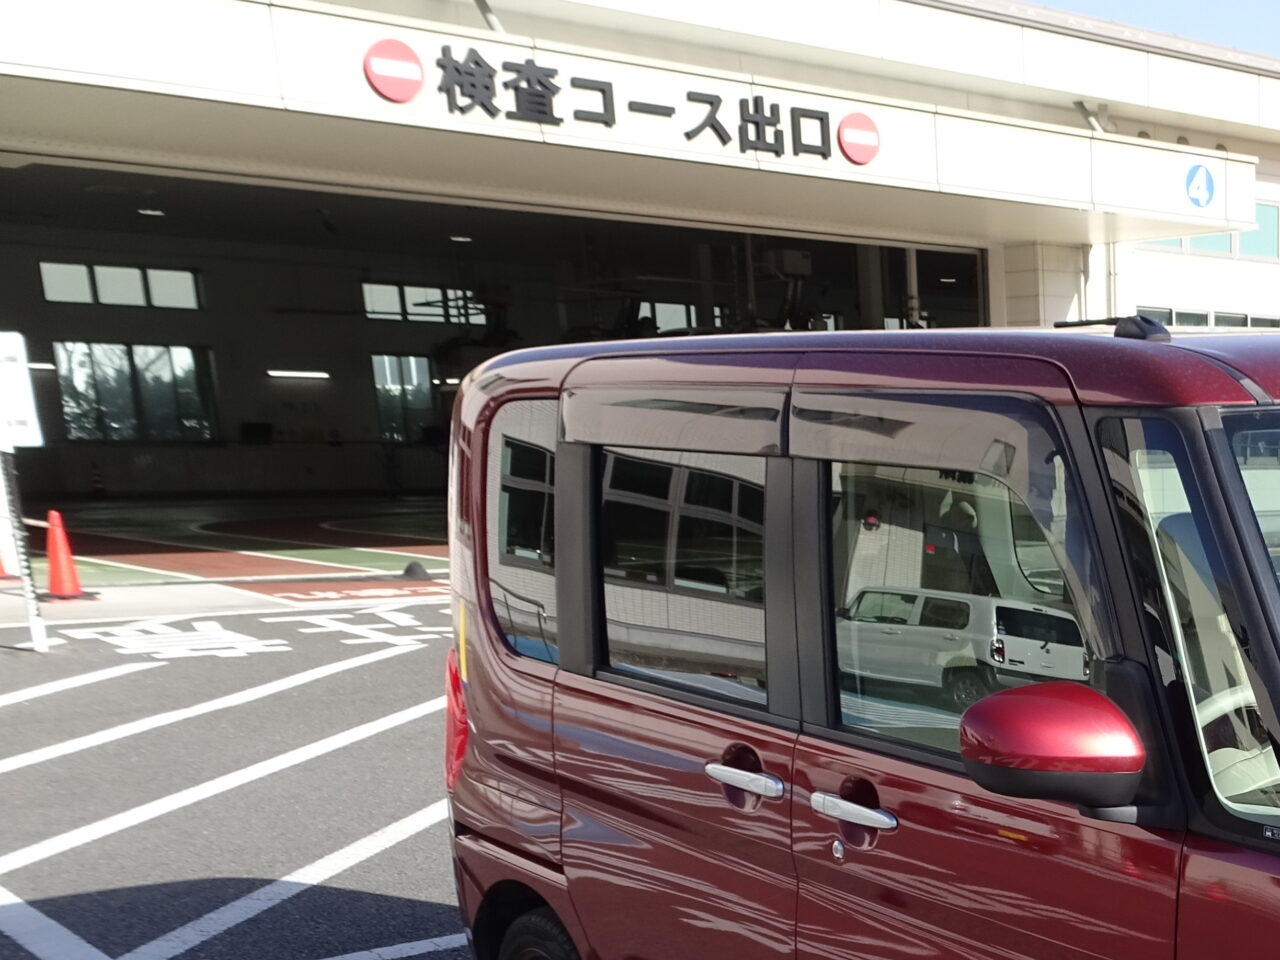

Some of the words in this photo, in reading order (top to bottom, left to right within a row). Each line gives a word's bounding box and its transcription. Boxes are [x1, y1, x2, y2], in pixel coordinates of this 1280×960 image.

[436, 45, 831, 159] 検査コース出口
[1188, 166, 1210, 207] 4
